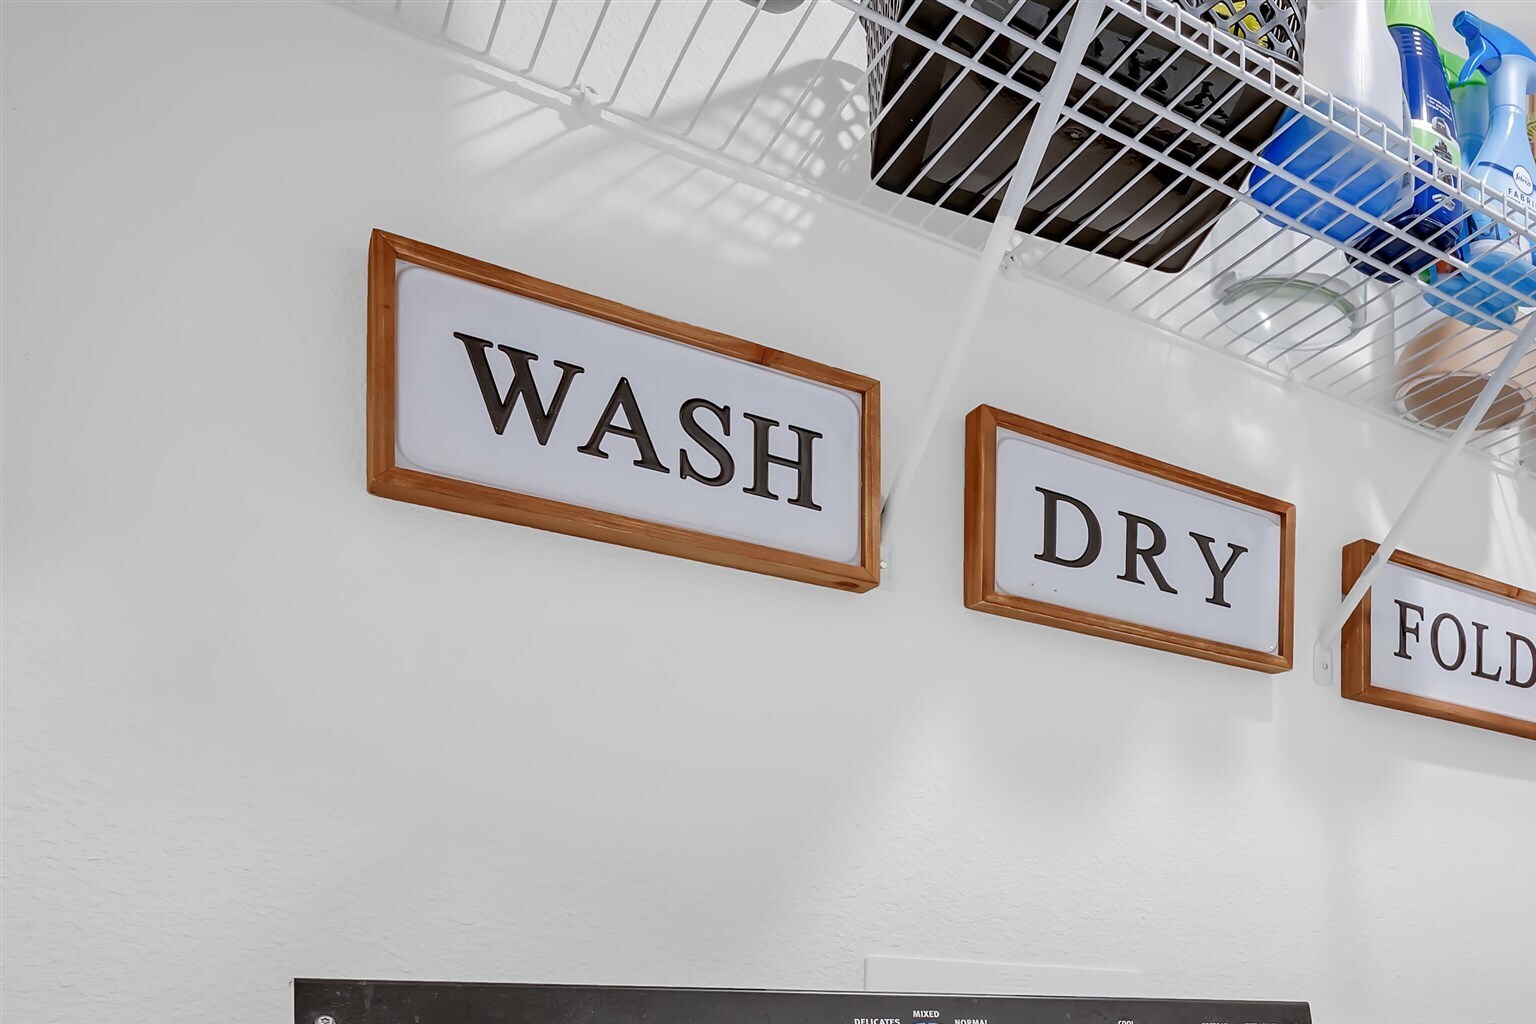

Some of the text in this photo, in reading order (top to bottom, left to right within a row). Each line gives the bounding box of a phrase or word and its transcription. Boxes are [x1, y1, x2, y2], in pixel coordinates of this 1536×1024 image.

[453, 331, 823, 511] WASH
[1033, 485, 1249, 609] DRY
[913, 1010, 940, 1018] MIXED
